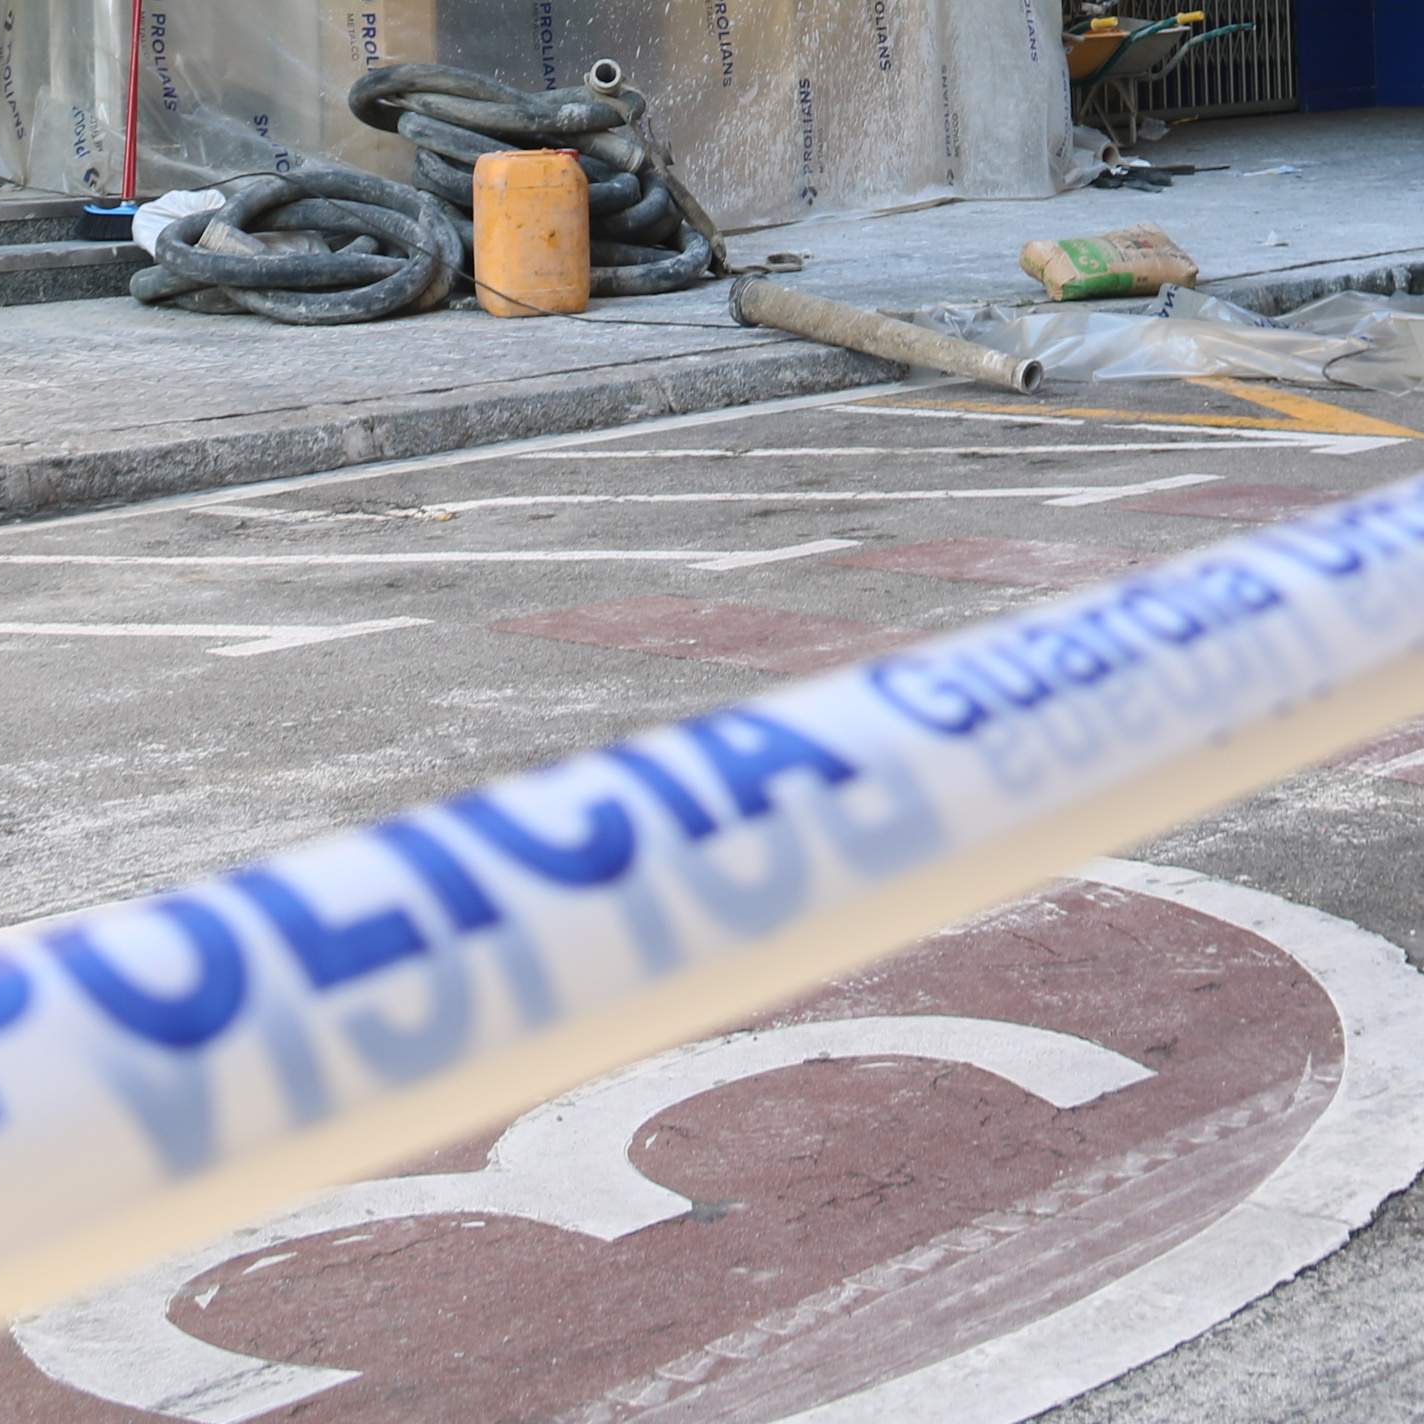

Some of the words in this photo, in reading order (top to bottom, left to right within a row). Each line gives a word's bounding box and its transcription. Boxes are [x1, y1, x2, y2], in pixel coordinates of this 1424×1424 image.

[150, 12, 178, 112] PROLIANS
[539, 1, 557, 90] PROLIAN
[866, 551, 1286, 738] Guardia
